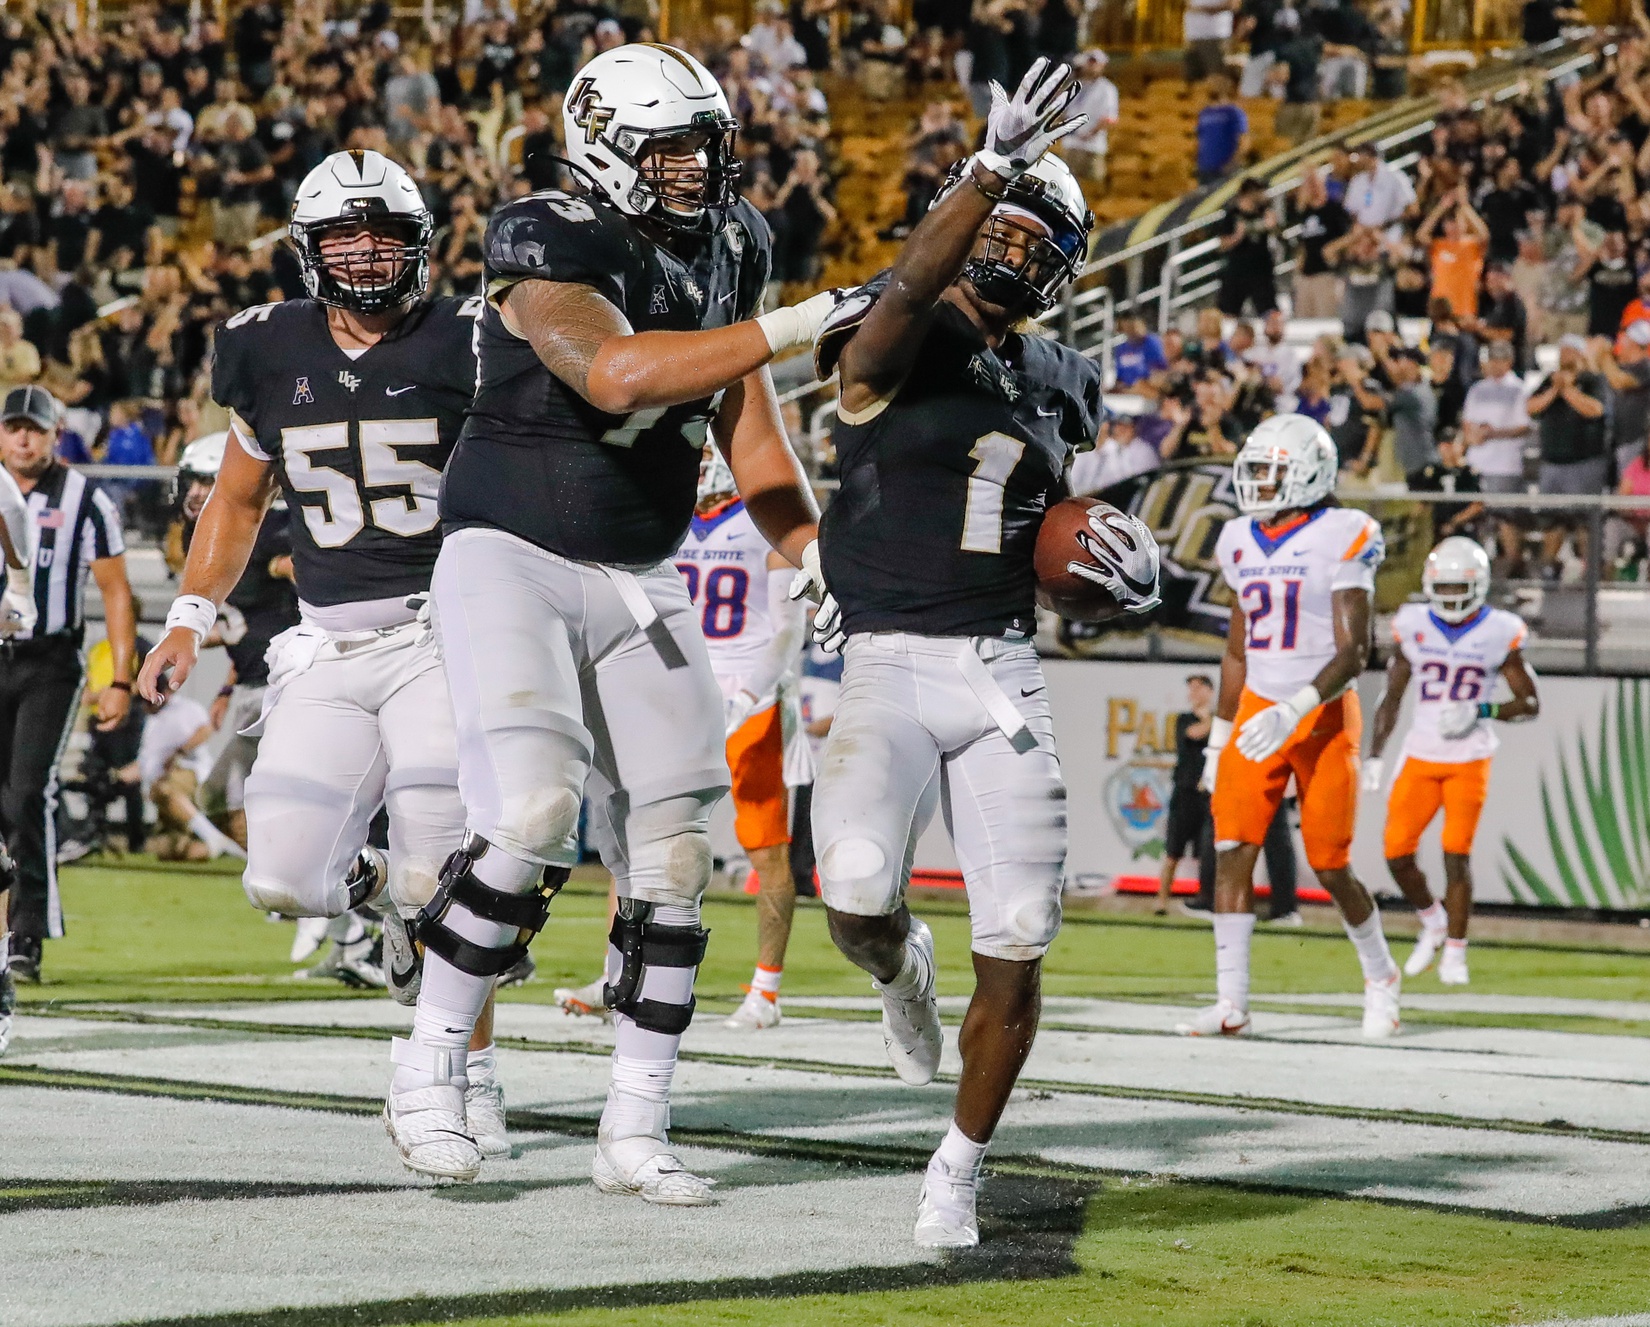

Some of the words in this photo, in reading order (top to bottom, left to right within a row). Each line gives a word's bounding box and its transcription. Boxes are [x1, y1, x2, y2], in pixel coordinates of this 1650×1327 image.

[567, 77, 617, 145] UCF
[681, 280, 704, 306] UCF
[292, 376, 315, 405] A
[338, 370, 362, 393] UCF
[280, 417, 441, 549] 55
[960, 430, 1026, 554] 1
[702, 549, 745, 560] STATE
[1012, 618, 1020, 629] S
[1242, 579, 1303, 650] 21
[1420, 661, 1486, 702] 26
